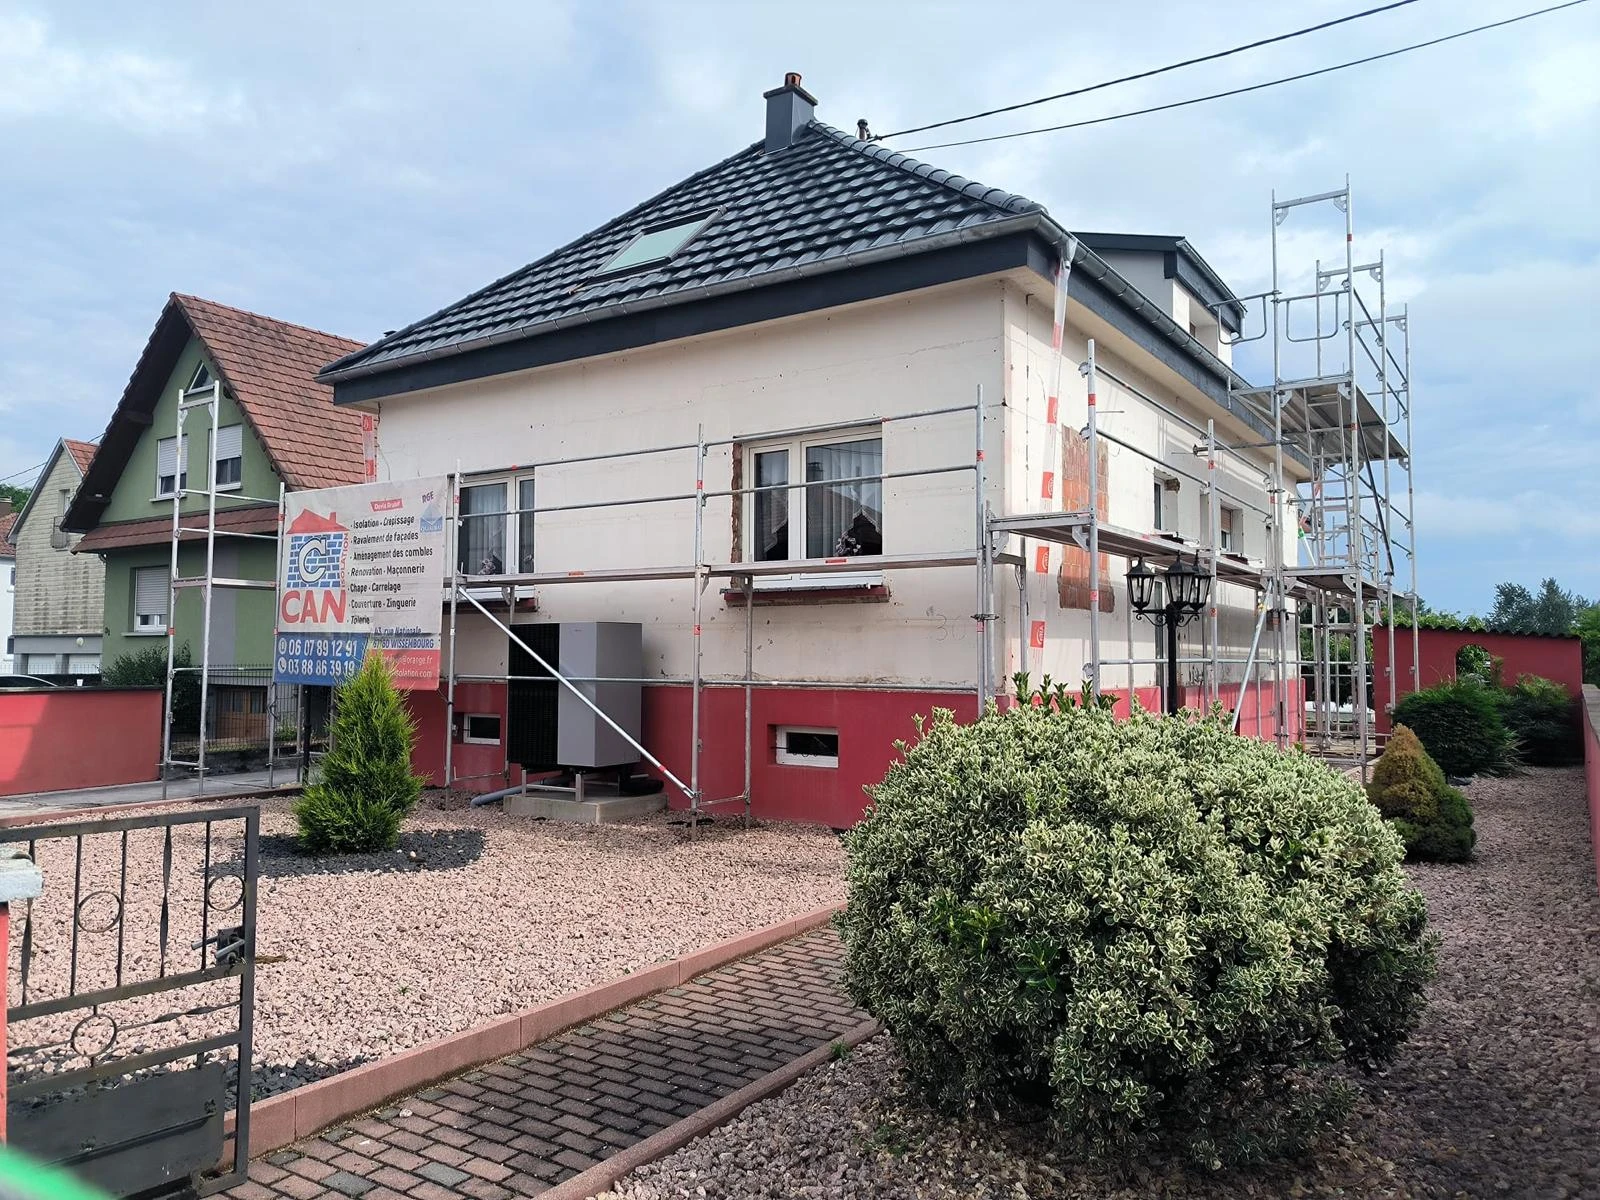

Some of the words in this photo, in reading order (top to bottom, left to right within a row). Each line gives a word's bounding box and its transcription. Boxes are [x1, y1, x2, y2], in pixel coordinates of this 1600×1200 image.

[422, 491, 434, 503] RGE
[353, 519, 379, 529] Isolation
[353, 534, 385, 545] Ravalement
[385, 533, 393, 542] de
[393, 531, 419, 543] façades
[392, 548, 404, 558] des
[404, 547, 433, 557] combles
[341, 533, 349, 589] ISOLATION
[386, 563, 425, 577] Maçonnerie
[350, 583, 368, 594] Chape
[372, 581, 401, 593] Carrelage
[282, 591, 346, 623] CAN
[351, 599, 382, 609] Couverture
[386, 597, 417, 610] Zinguerie
[288, 639, 302, 656] 06
[304, 639, 315, 657] 07
[316, 639, 329, 657] 89
[331, 640, 343, 657] 12
[345, 640, 358, 657] 91
[391, 638, 434, 649] WISSEMBOURG
[288, 658, 299, 675] 03
[301, 659, 314, 676] 88
[316, 659, 328, 676] 86
[329, 659, 342, 677] 39
[343, 660, 355, 677] 19
